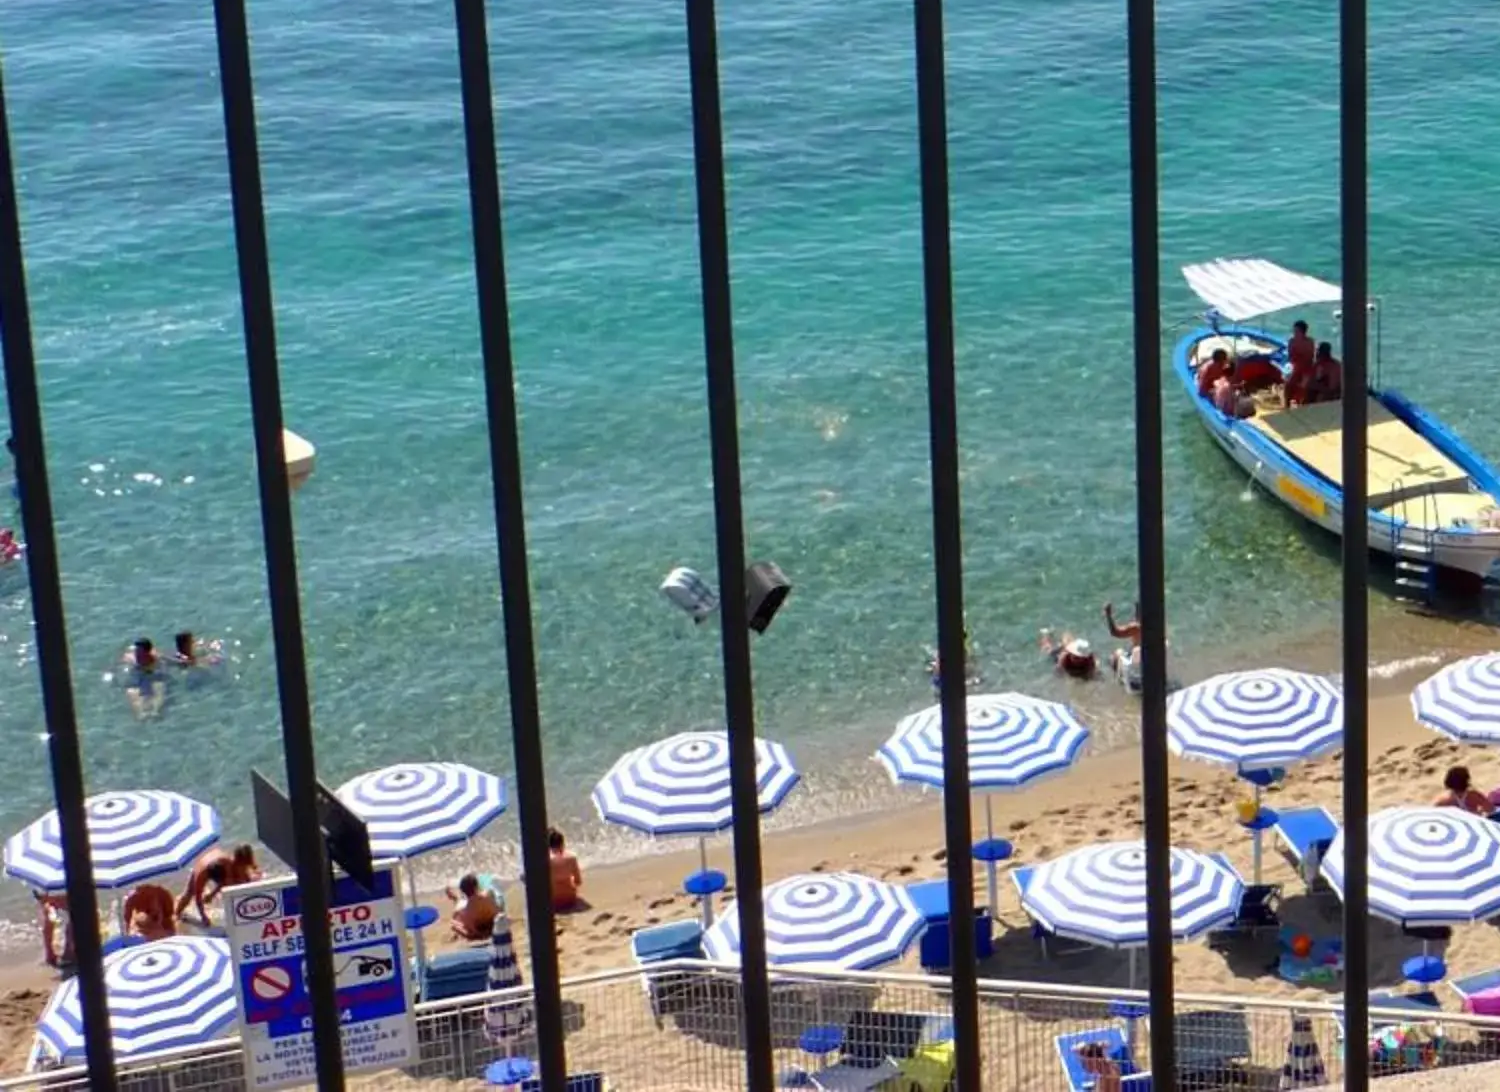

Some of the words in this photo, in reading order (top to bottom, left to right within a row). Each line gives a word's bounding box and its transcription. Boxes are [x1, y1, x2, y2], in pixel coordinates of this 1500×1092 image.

[243, 940, 280, 960] SELF
[286, 926, 354, 951] SECE
[358, 923, 377, 936] 24
[381, 918, 393, 933] H
[261, 906, 371, 939] APTO
